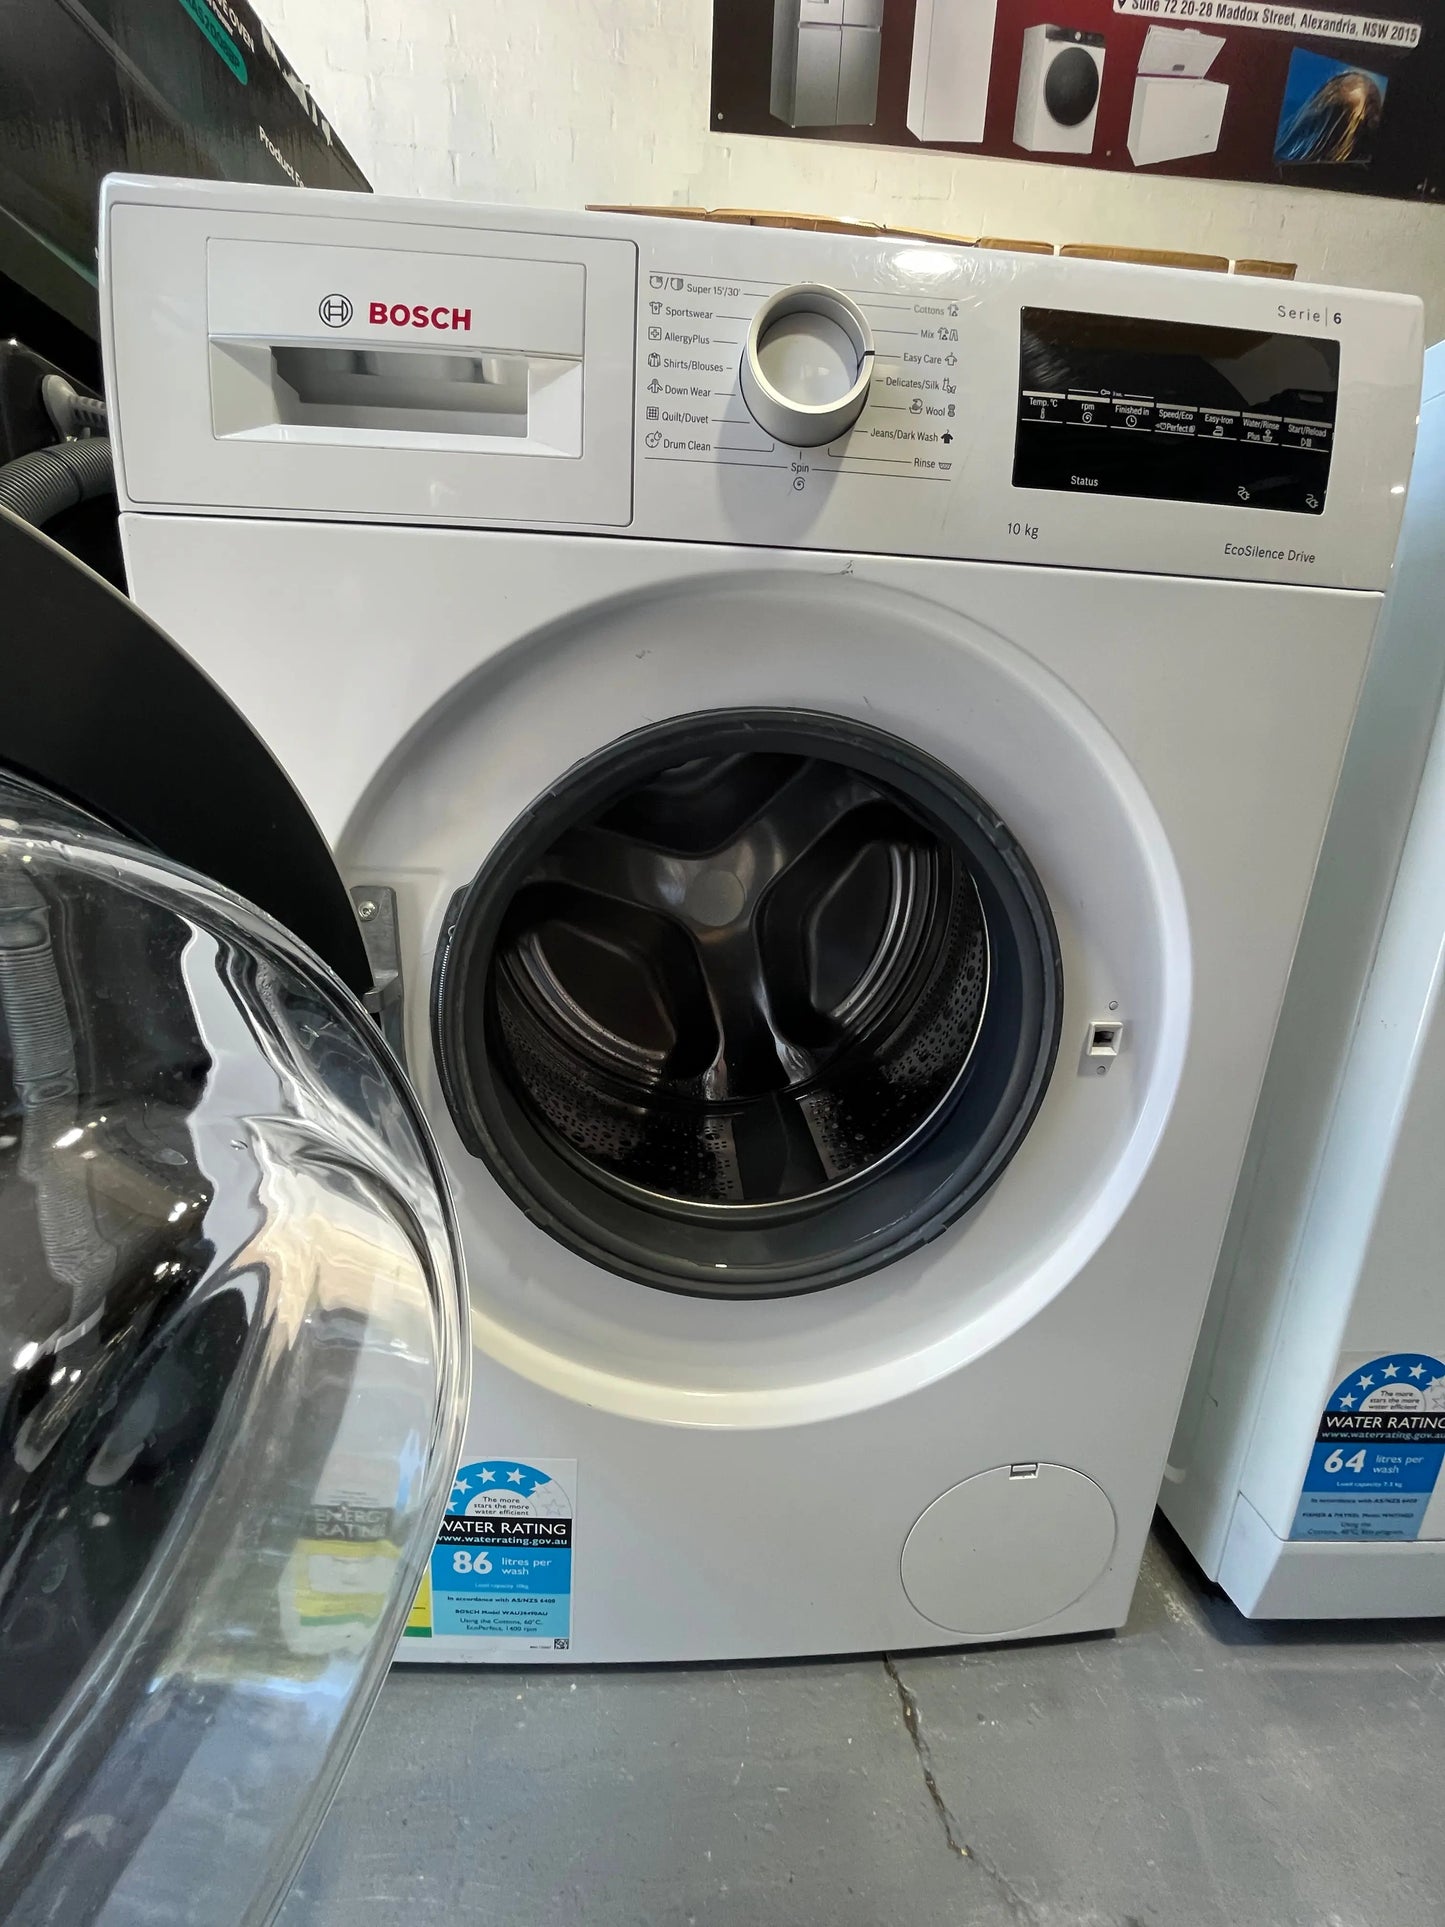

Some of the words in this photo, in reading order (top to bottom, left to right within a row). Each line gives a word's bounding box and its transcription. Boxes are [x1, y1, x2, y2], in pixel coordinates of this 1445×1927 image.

[1164, 0, 1177, 13] 72
[1180, 0, 1213, 17] 20-28
[1216, 3, 1259, 22] Maddox
[1262, 8, 1296, 28] Street,
[1300, 13, 1359, 36] Alexandria,
[1362, 22, 1389, 39] NSW
[1390, 25, 1418, 43] 2015
[259, 125, 295, 181] Product
[686, 283, 711, 295] Super
[665, 306, 714, 319] Sportswear
[913, 304, 945, 315] Cottons
[1277, 305, 1321, 323] Serie
[1333, 312, 1342, 324] 6
[369, 302, 472, 331] BOSCH
[664, 331, 710, 345] AllergyPlus
[920, 329, 935, 339] Mix
[903, 352, 922, 364] Easy
[923, 354, 942, 364] Care
[663, 358, 724, 372] Shirts/Blouses
[885, 376, 940, 390] Delicates/Silk
[664, 384, 688, 396] Down
[690, 386, 711, 397] Wear
[1029, 397, 1049, 407] Temp.
[1081, 403, 1095, 412] rpm
[925, 406, 946, 416] Wool
[1115, 405, 1142, 415] Finished
[1158, 409, 1194, 420] Speed/Eco
[661, 411, 709, 424] Quilt/Duvet
[1204, 413, 1234, 425] Easy-Iron
[1166, 423, 1189, 433] Perfect
[1242, 418, 1280, 431] Water/Rinse
[1287, 424, 1327, 437] Start/Reload
[870, 428, 916, 440] Jeans/Dark
[917, 431, 939, 442] Wash
[1246, 432, 1261, 441] Plus
[663, 438, 686, 450] Drum
[687, 440, 711, 451] Clean
[790, 463, 810, 474] Spin
[913, 457, 936, 468] Rinse
[1070, 475, 1099, 487] Status
[1007, 522, 1021, 535] 10
[1024, 523, 1040, 540] kg
[1224, 542, 1285, 560] EcoSilence
[1288, 549, 1316, 565] Drive
[1326, 1416, 1382, 1429] WATER
[1323, 1448, 1367, 1473] 64
[1375, 1455, 1402, 1464] litres
[1405, 1456, 1424, 1465] per
[1372, 1465, 1400, 1474] wash
[501, 1522, 567, 1535] RATING
[453, 1550, 493, 1575] 86
[501, 1557, 529, 1567] litres
[533, 1560, 552, 1569] per
[501, 1567, 529, 1575] wash
